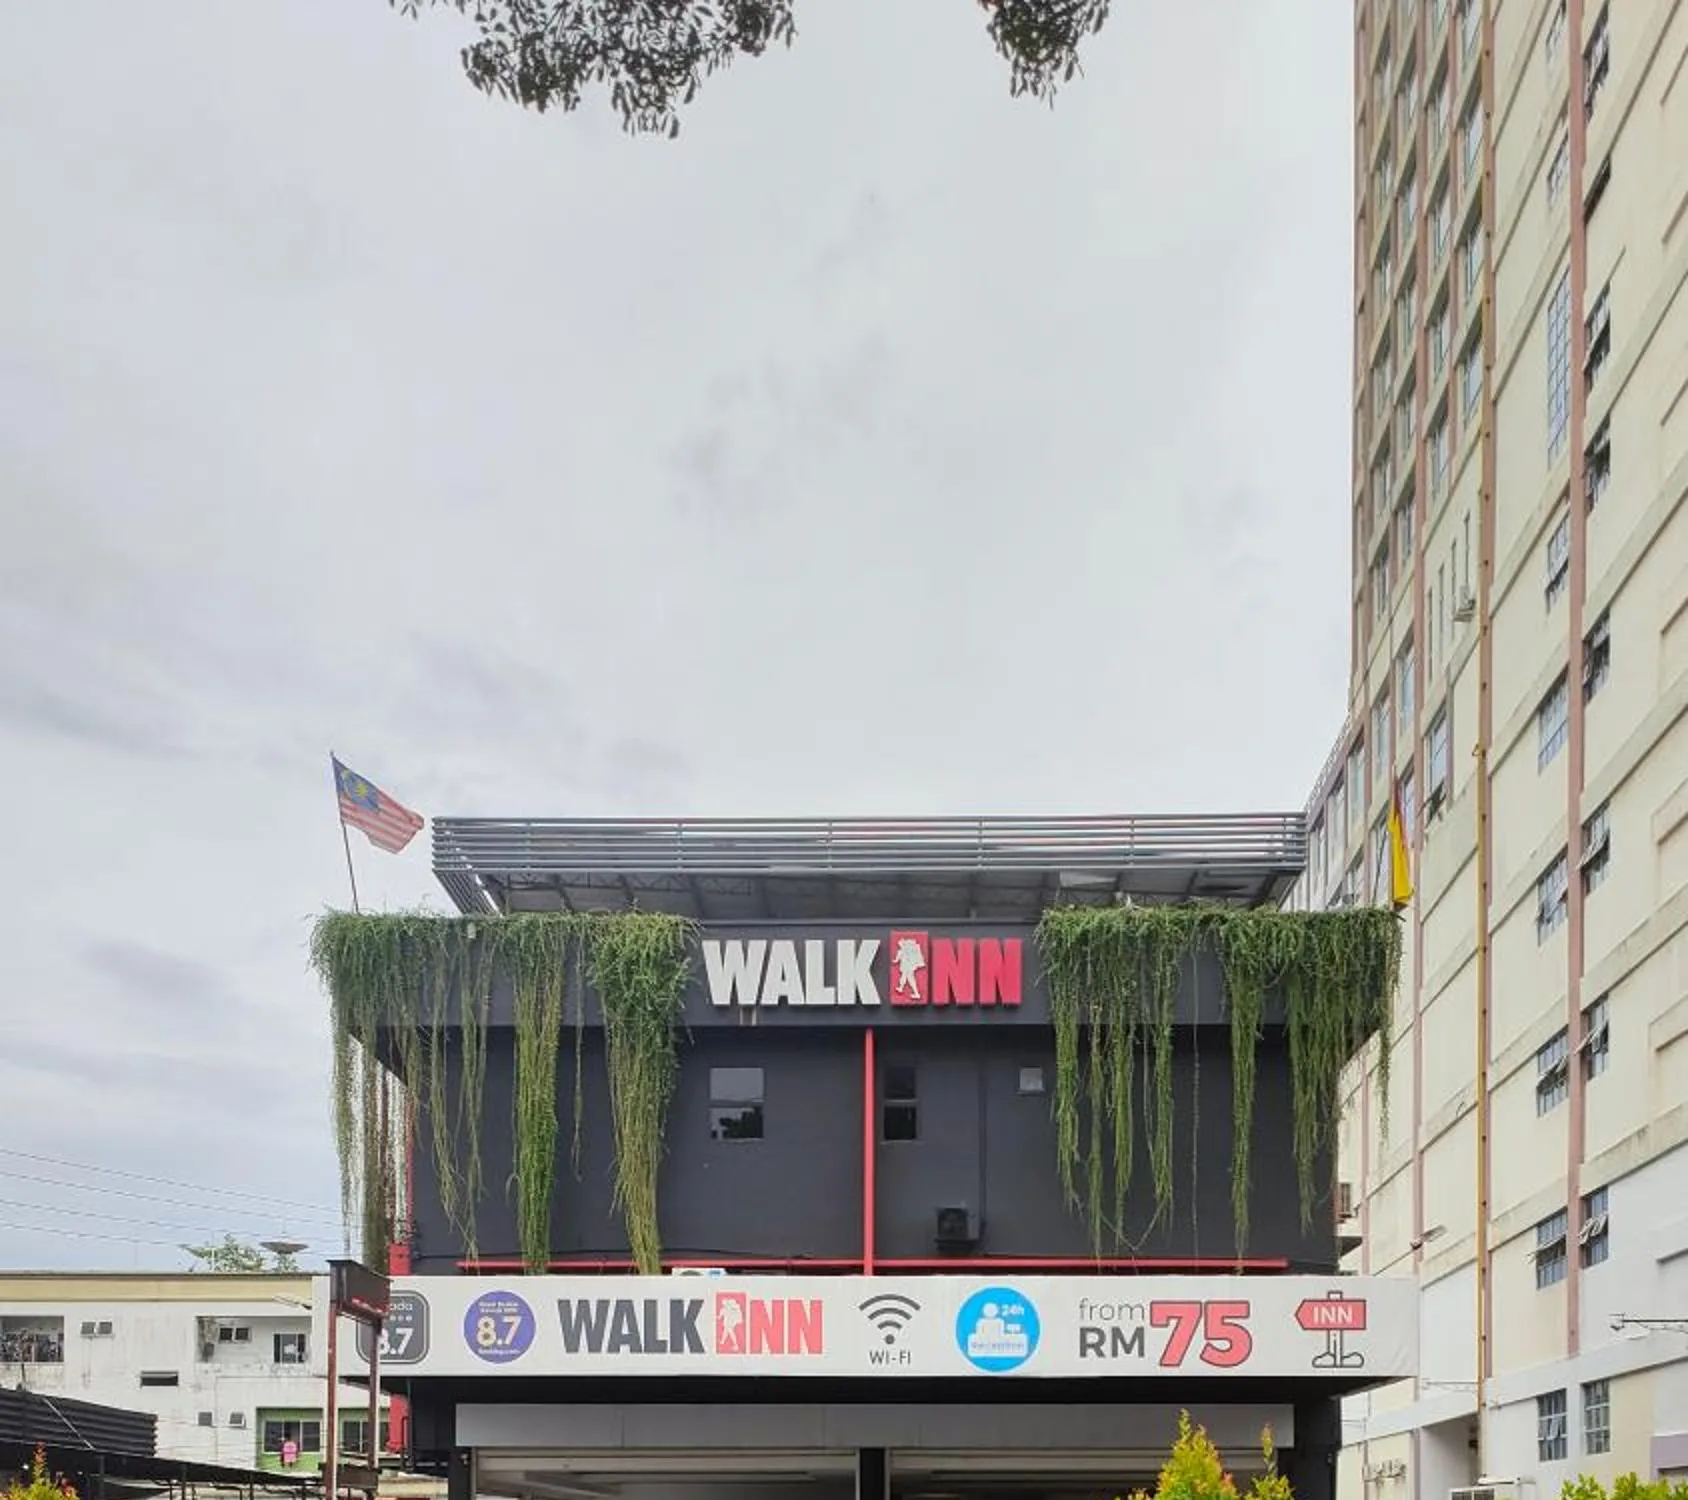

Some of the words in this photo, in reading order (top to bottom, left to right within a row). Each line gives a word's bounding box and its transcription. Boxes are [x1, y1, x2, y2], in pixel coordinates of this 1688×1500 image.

[702, 939, 881, 1006] WALK
[389, 1301, 413, 1311] oda
[1079, 1298, 1145, 1321] from
[1312, 1306, 1353, 1324] INN
[476, 1315, 522, 1347] 8.7
[557, 1299, 705, 1353] WALK
[1079, 1326, 1145, 1358] RM
[1149, 1300, 1253, 1367] 75
[869, 1351, 911, 1365] WI-FI
